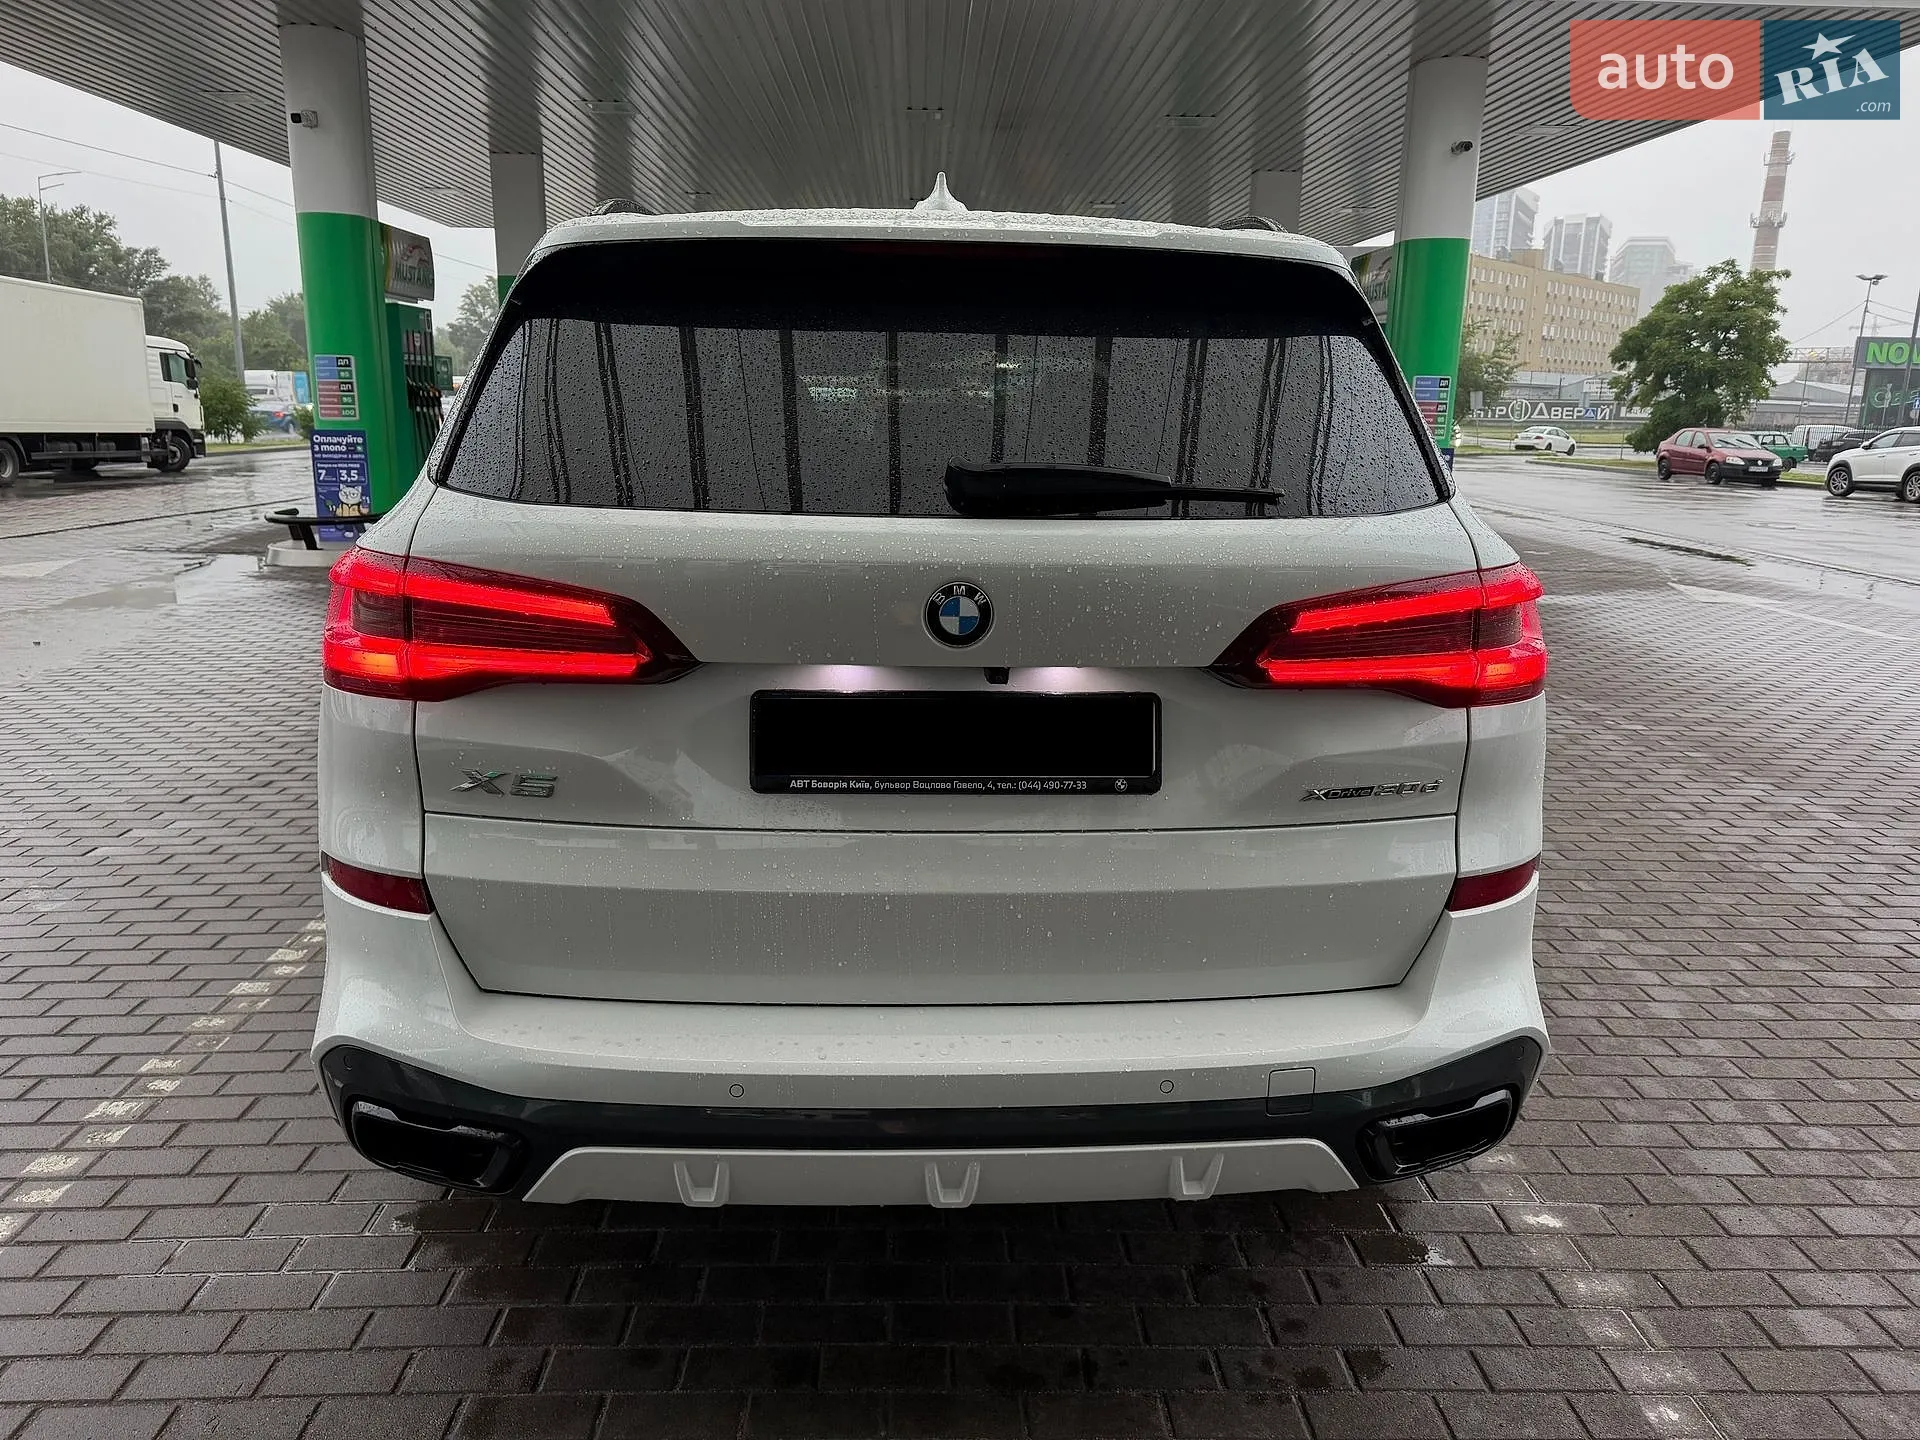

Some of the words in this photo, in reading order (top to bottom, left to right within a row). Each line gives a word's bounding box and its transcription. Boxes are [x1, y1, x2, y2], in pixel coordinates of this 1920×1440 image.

[1531, 402, 1609, 420] ДВЕРЙ
[313, 434, 363, 444] Оплачуйте
[317, 469, 326, 480] 7
[339, 469, 358, 482] 3,5
[932, 585, 987, 606] BMW
[448, 768, 558, 798] X5
[811, 779, 848, 790] Баварія
[874, 780, 911, 791] бульвар
[912, 780, 951, 791] Вацлава
[1018, 780, 1042, 791] (044)
[1043, 780, 1087, 791] 490-77-33
